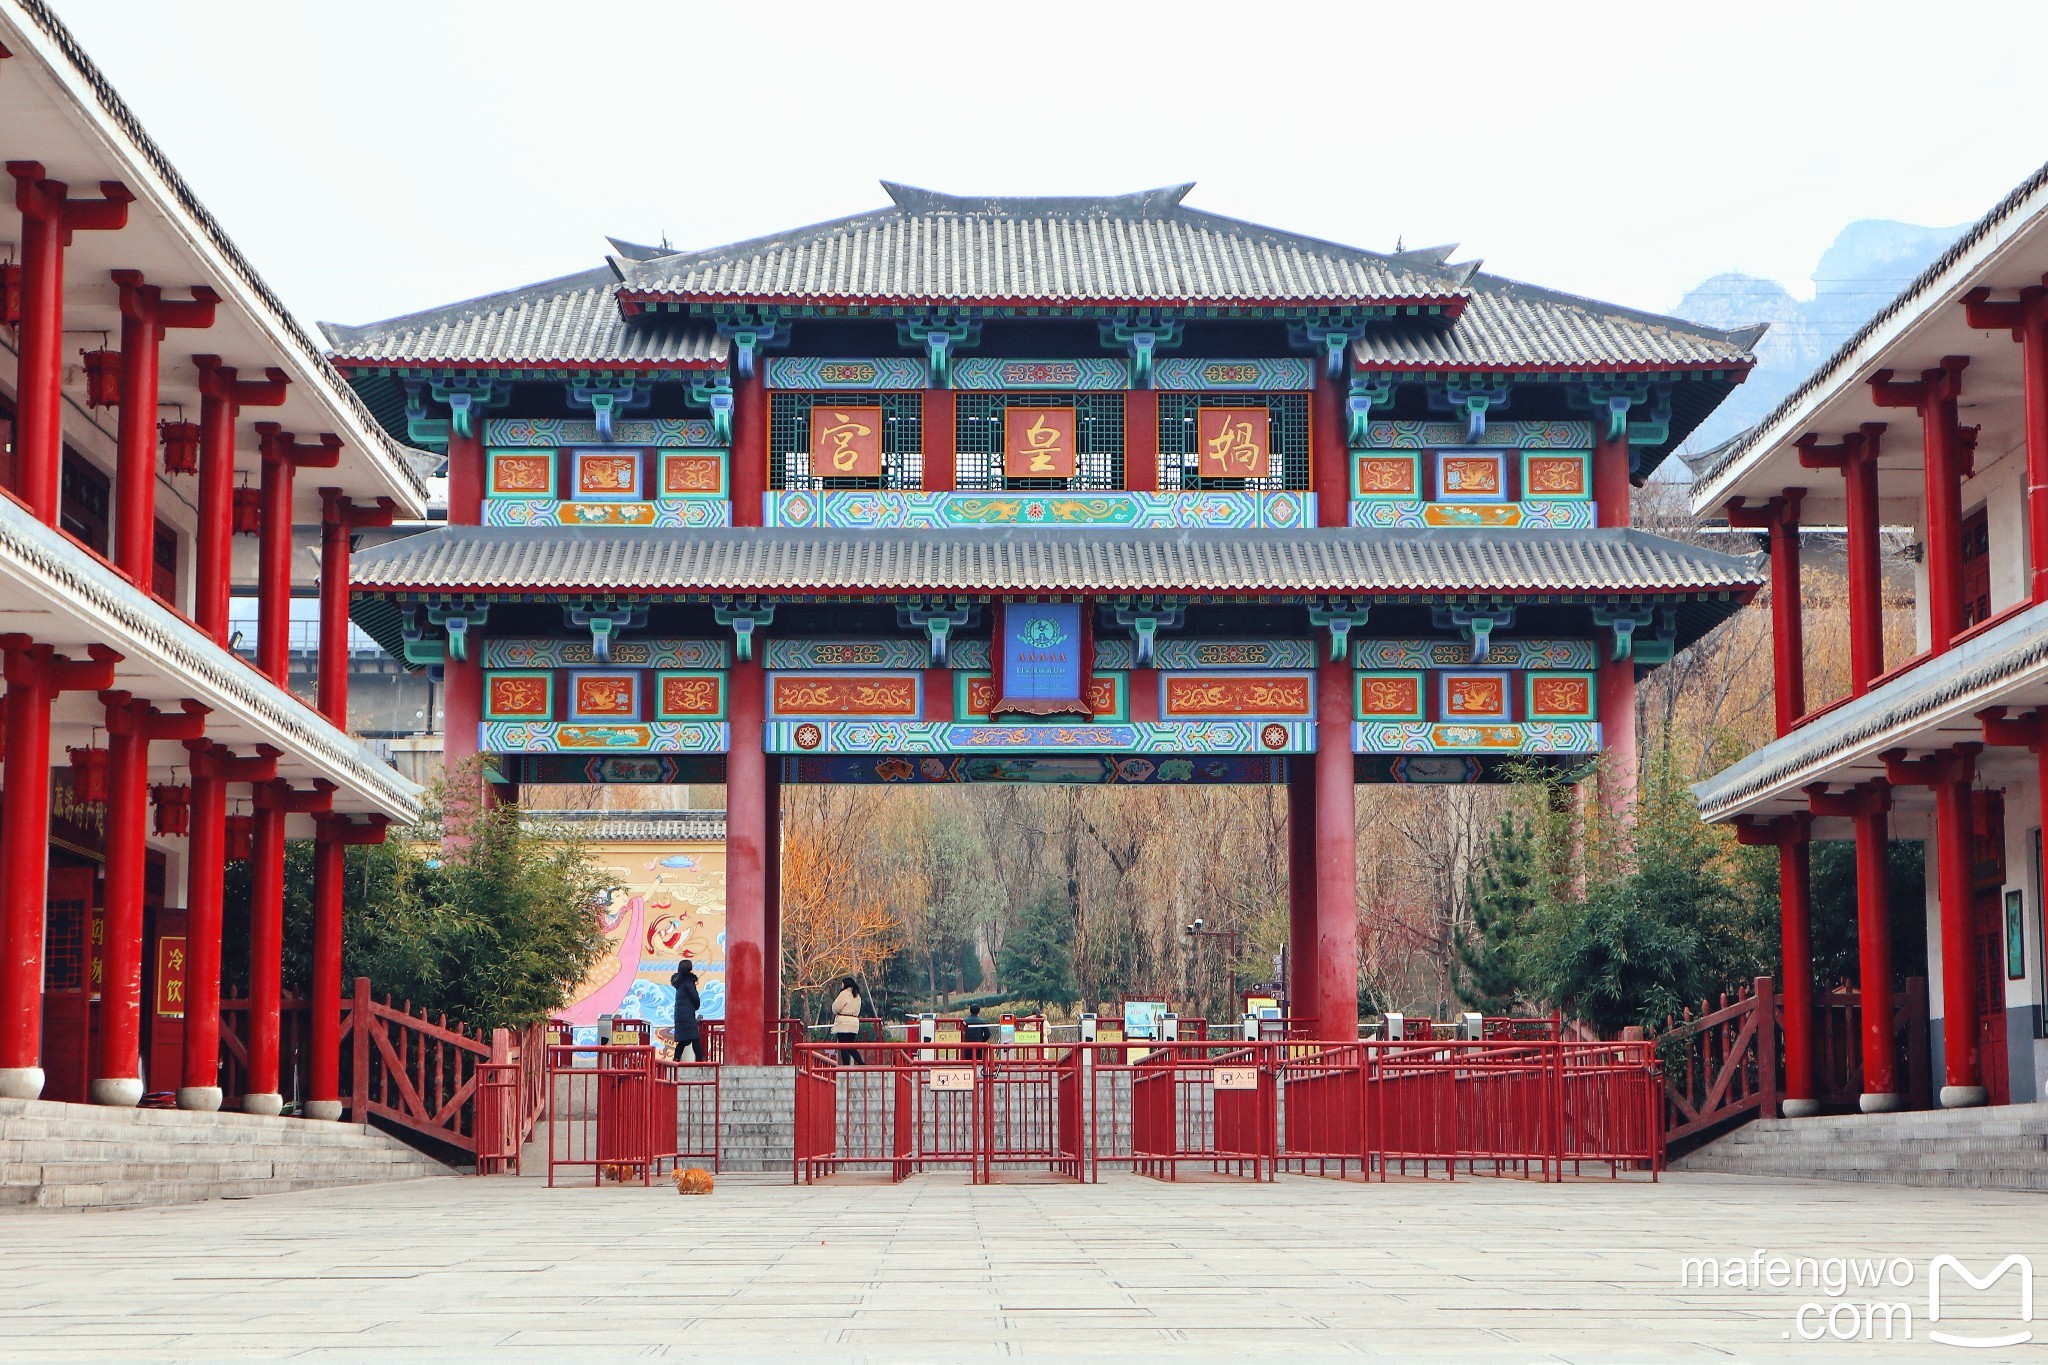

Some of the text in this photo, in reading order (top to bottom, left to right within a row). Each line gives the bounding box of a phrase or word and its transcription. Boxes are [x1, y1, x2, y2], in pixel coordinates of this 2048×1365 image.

[1019, 413, 1062, 472] 皇
[166, 948, 184, 1003] 冷饮
[952, 1073, 971, 1081] 入口
[1236, 1072, 1255, 1080] 入口
